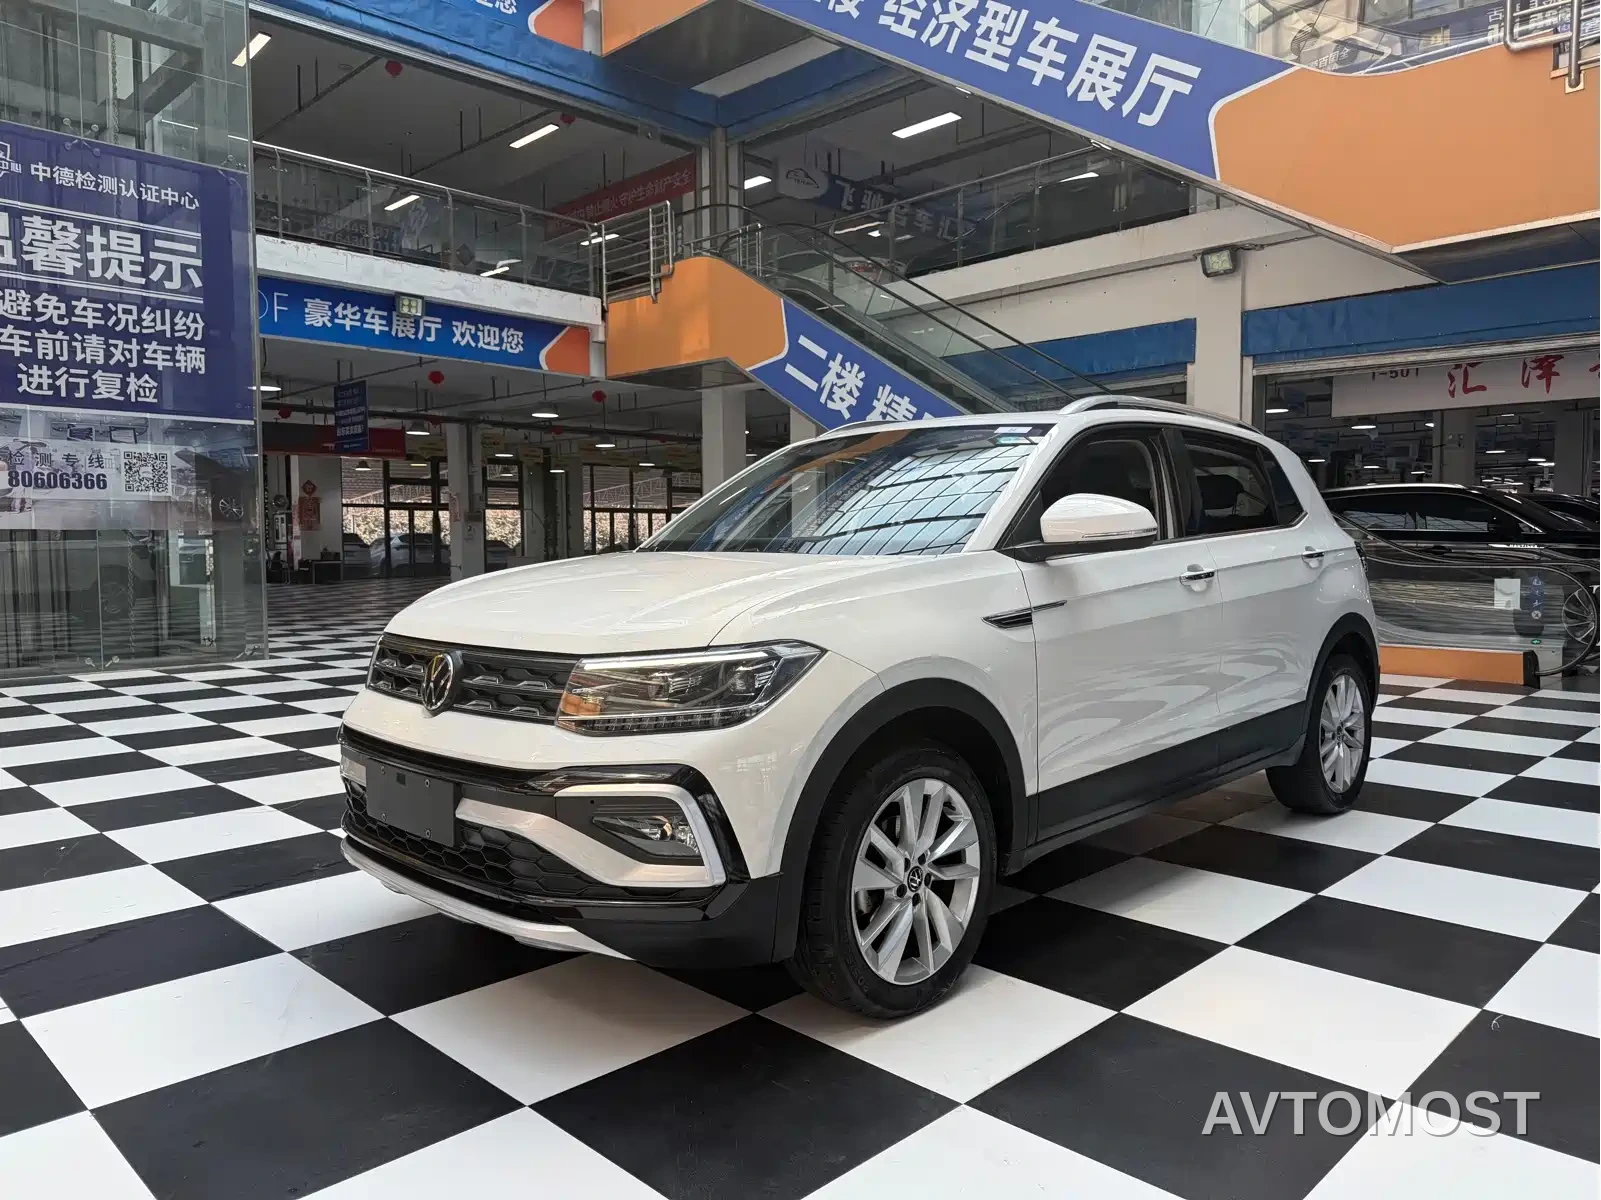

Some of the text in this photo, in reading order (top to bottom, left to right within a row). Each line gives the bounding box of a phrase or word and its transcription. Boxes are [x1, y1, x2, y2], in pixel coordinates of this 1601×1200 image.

[878, 0, 1202, 127] 经济型车展厅
[30, 161, 200, 210] 中德检测认证中心
[0, 288, 205, 341] 避免车况纠纷
[303, 298, 443, 342] 豪华车展厅
[452, 320, 525, 354] 欢迎您
[0, 324, 206, 375] 车前请对车辆
[17, 363, 159, 403] 进行复检
[784, 334, 936, 422] 二楼 精
[8, 449, 106, 469] 检测专线
[8, 470, 108, 490] 80606366
